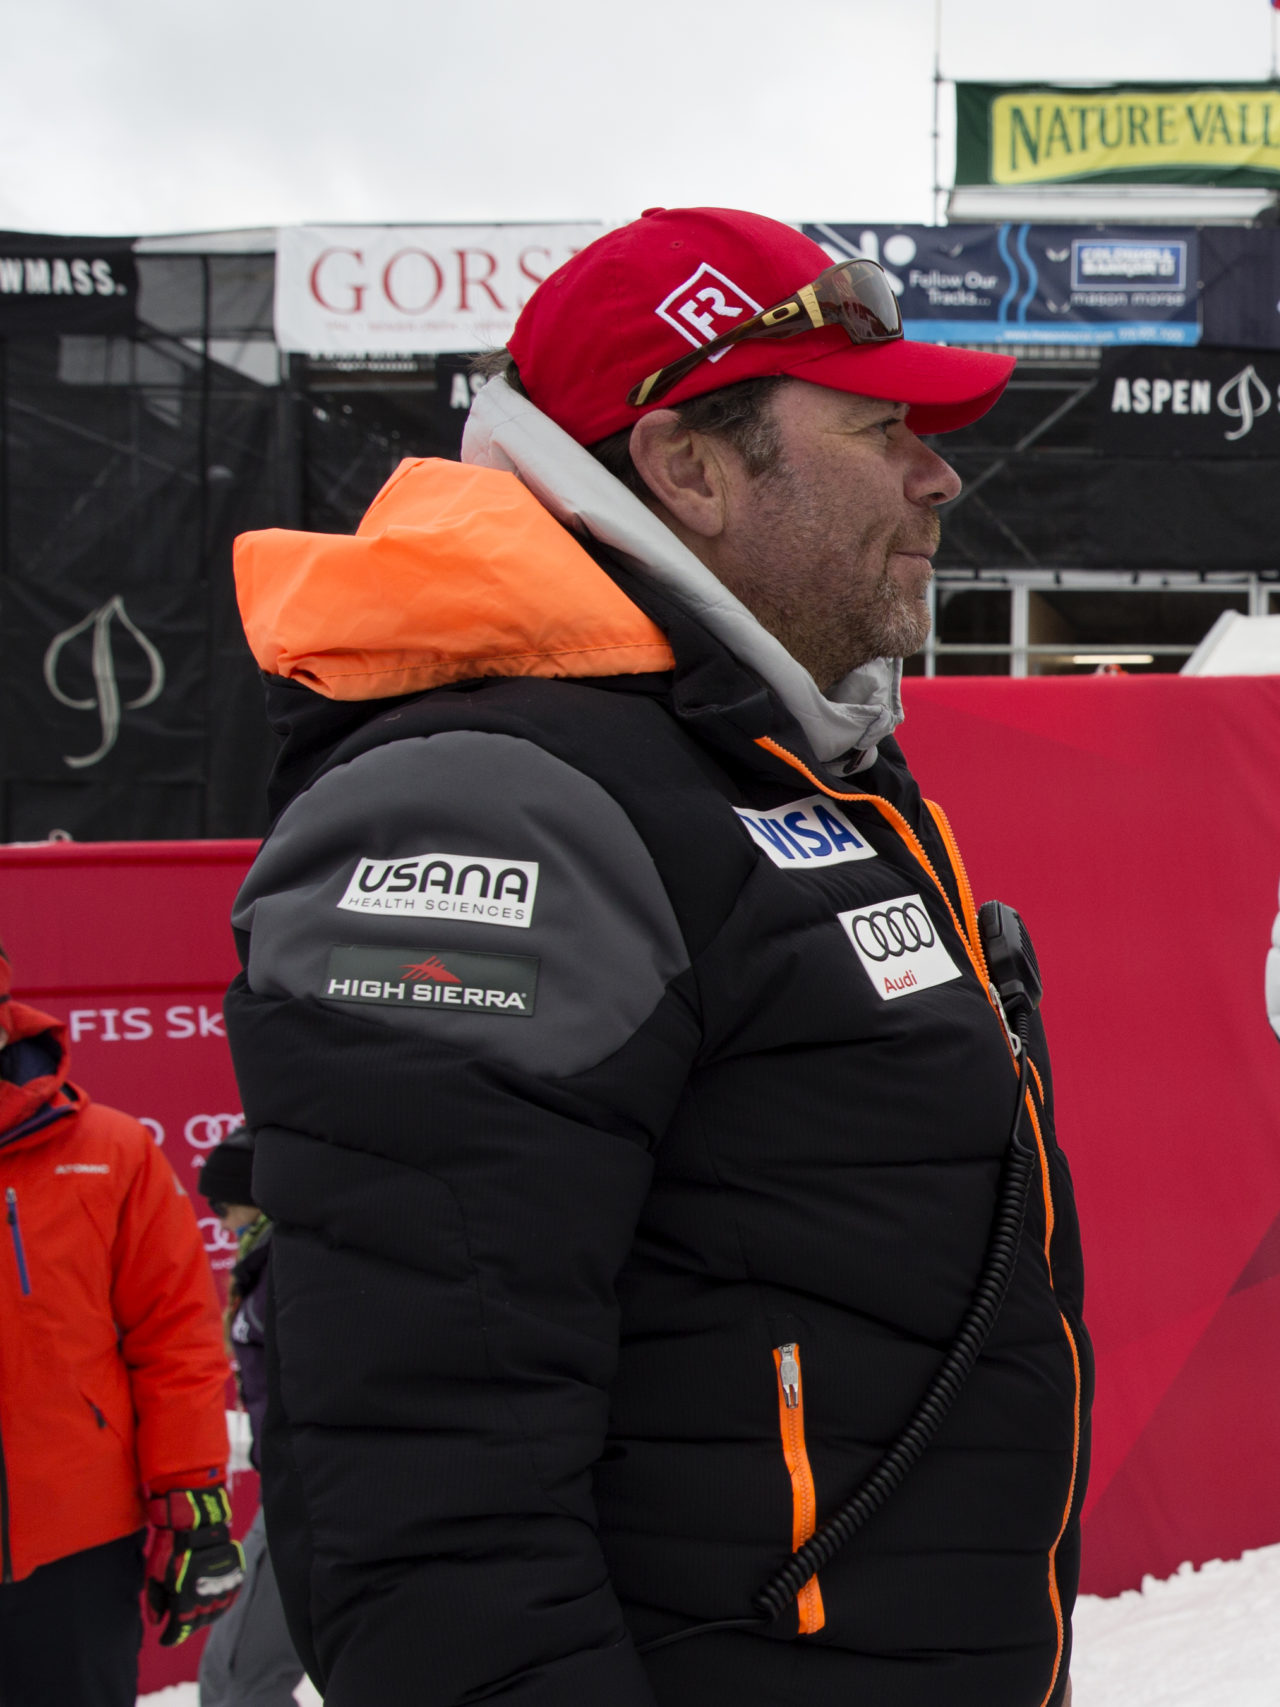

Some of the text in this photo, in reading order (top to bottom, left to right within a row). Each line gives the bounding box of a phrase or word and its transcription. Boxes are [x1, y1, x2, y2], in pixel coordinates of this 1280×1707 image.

[1009, 106, 1177, 172] NATURE
[1111, 377, 1211, 415] ASPEN
[739, 804, 864, 860] VISA
[358, 860, 529, 903] USANA
[348, 897, 525, 920] HEALTH SCIENCES
[327, 979, 405, 1000] HIGH
[883, 969, 918, 993] Audi
[69, 1007, 153, 1042] FIS
